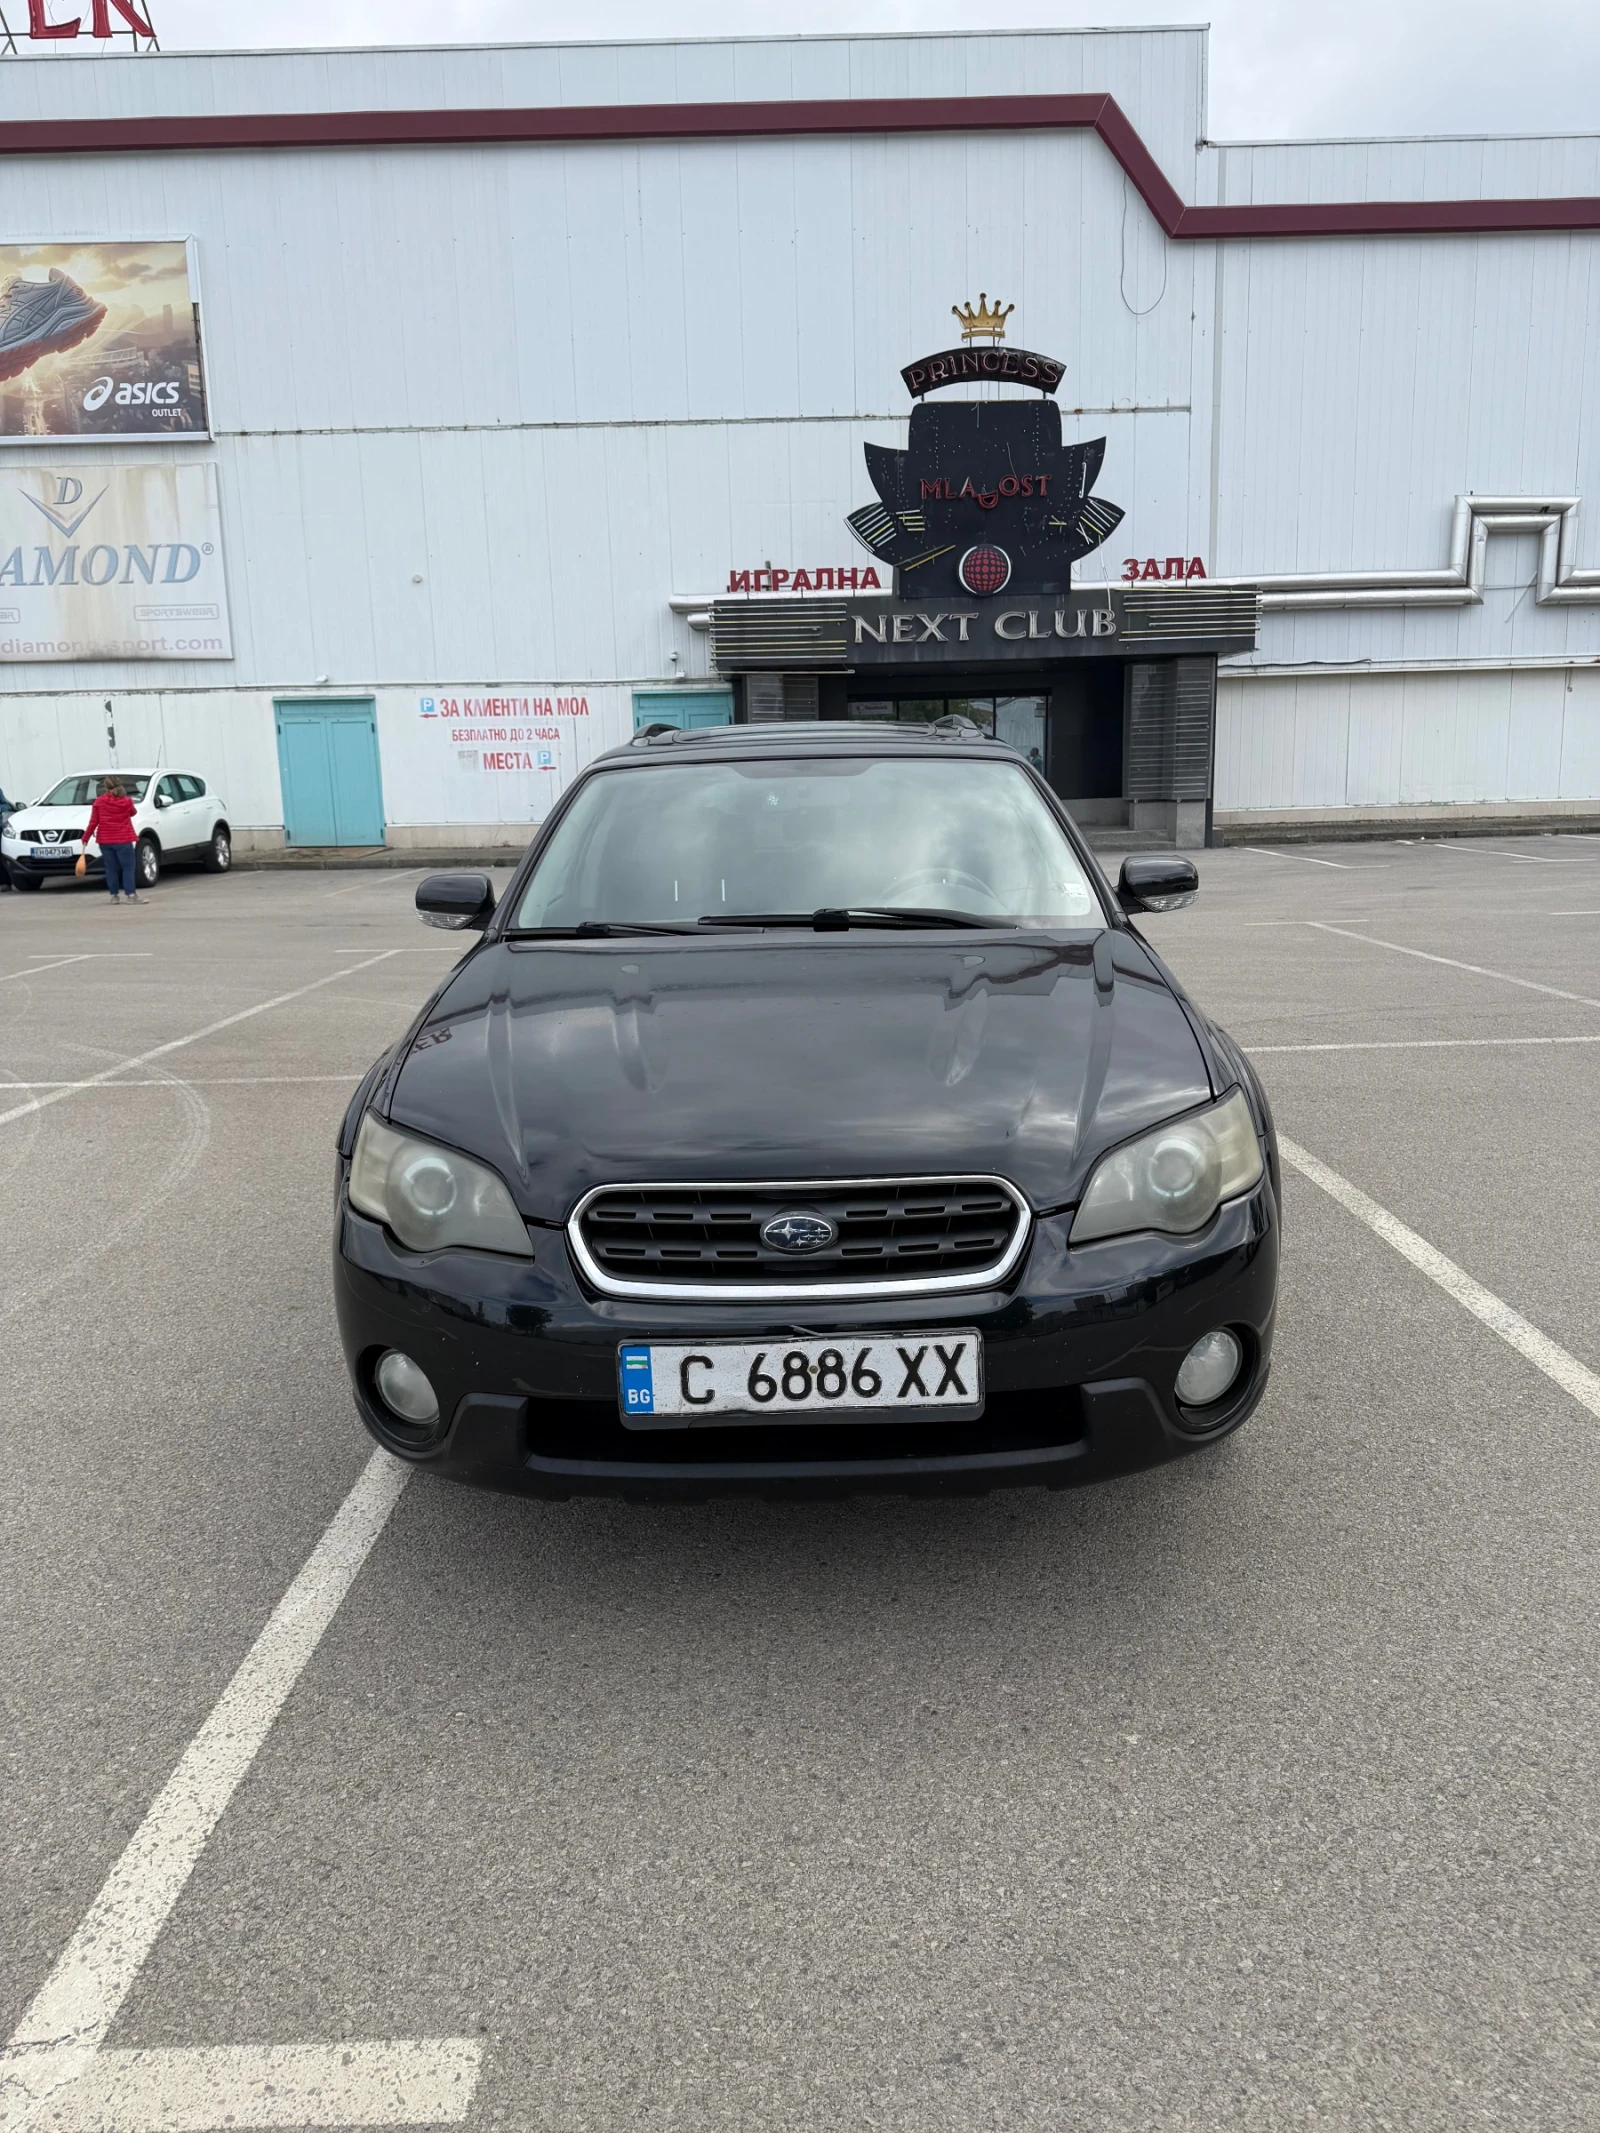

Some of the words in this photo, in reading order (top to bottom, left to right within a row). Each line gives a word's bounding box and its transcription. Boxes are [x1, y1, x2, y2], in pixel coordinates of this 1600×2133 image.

[907, 352, 1059, 389] PRINCESS
[151, 408, 182, 417] OUTLET
[920, 474, 1052, 509] MLADOST
[730, 567, 881, 593] ИГРАЛНА
[1121, 557, 1207, 581] ЗАЛА
[851, 612, 979, 643] NEXT
[994, 609, 1117, 640] CLUB
[440, 699, 460, 718] ЗА
[463, 698, 529, 717] КЛИЕНТИ
[533, 698, 553, 716] НА
[557, 697, 589, 716] МОЛ
[452, 729, 507, 742] БЕЗПЛАТНО
[510, 728, 524, 742] ДО
[527, 728, 533, 740] 2
[535, 728, 560, 740] ЧАСА
[483, 752, 533, 770] МЕСТА
[748, 1348, 882, 1402] 6886
[896, 1343, 968, 1398] XX
[628, 1389, 650, 1404] BG
